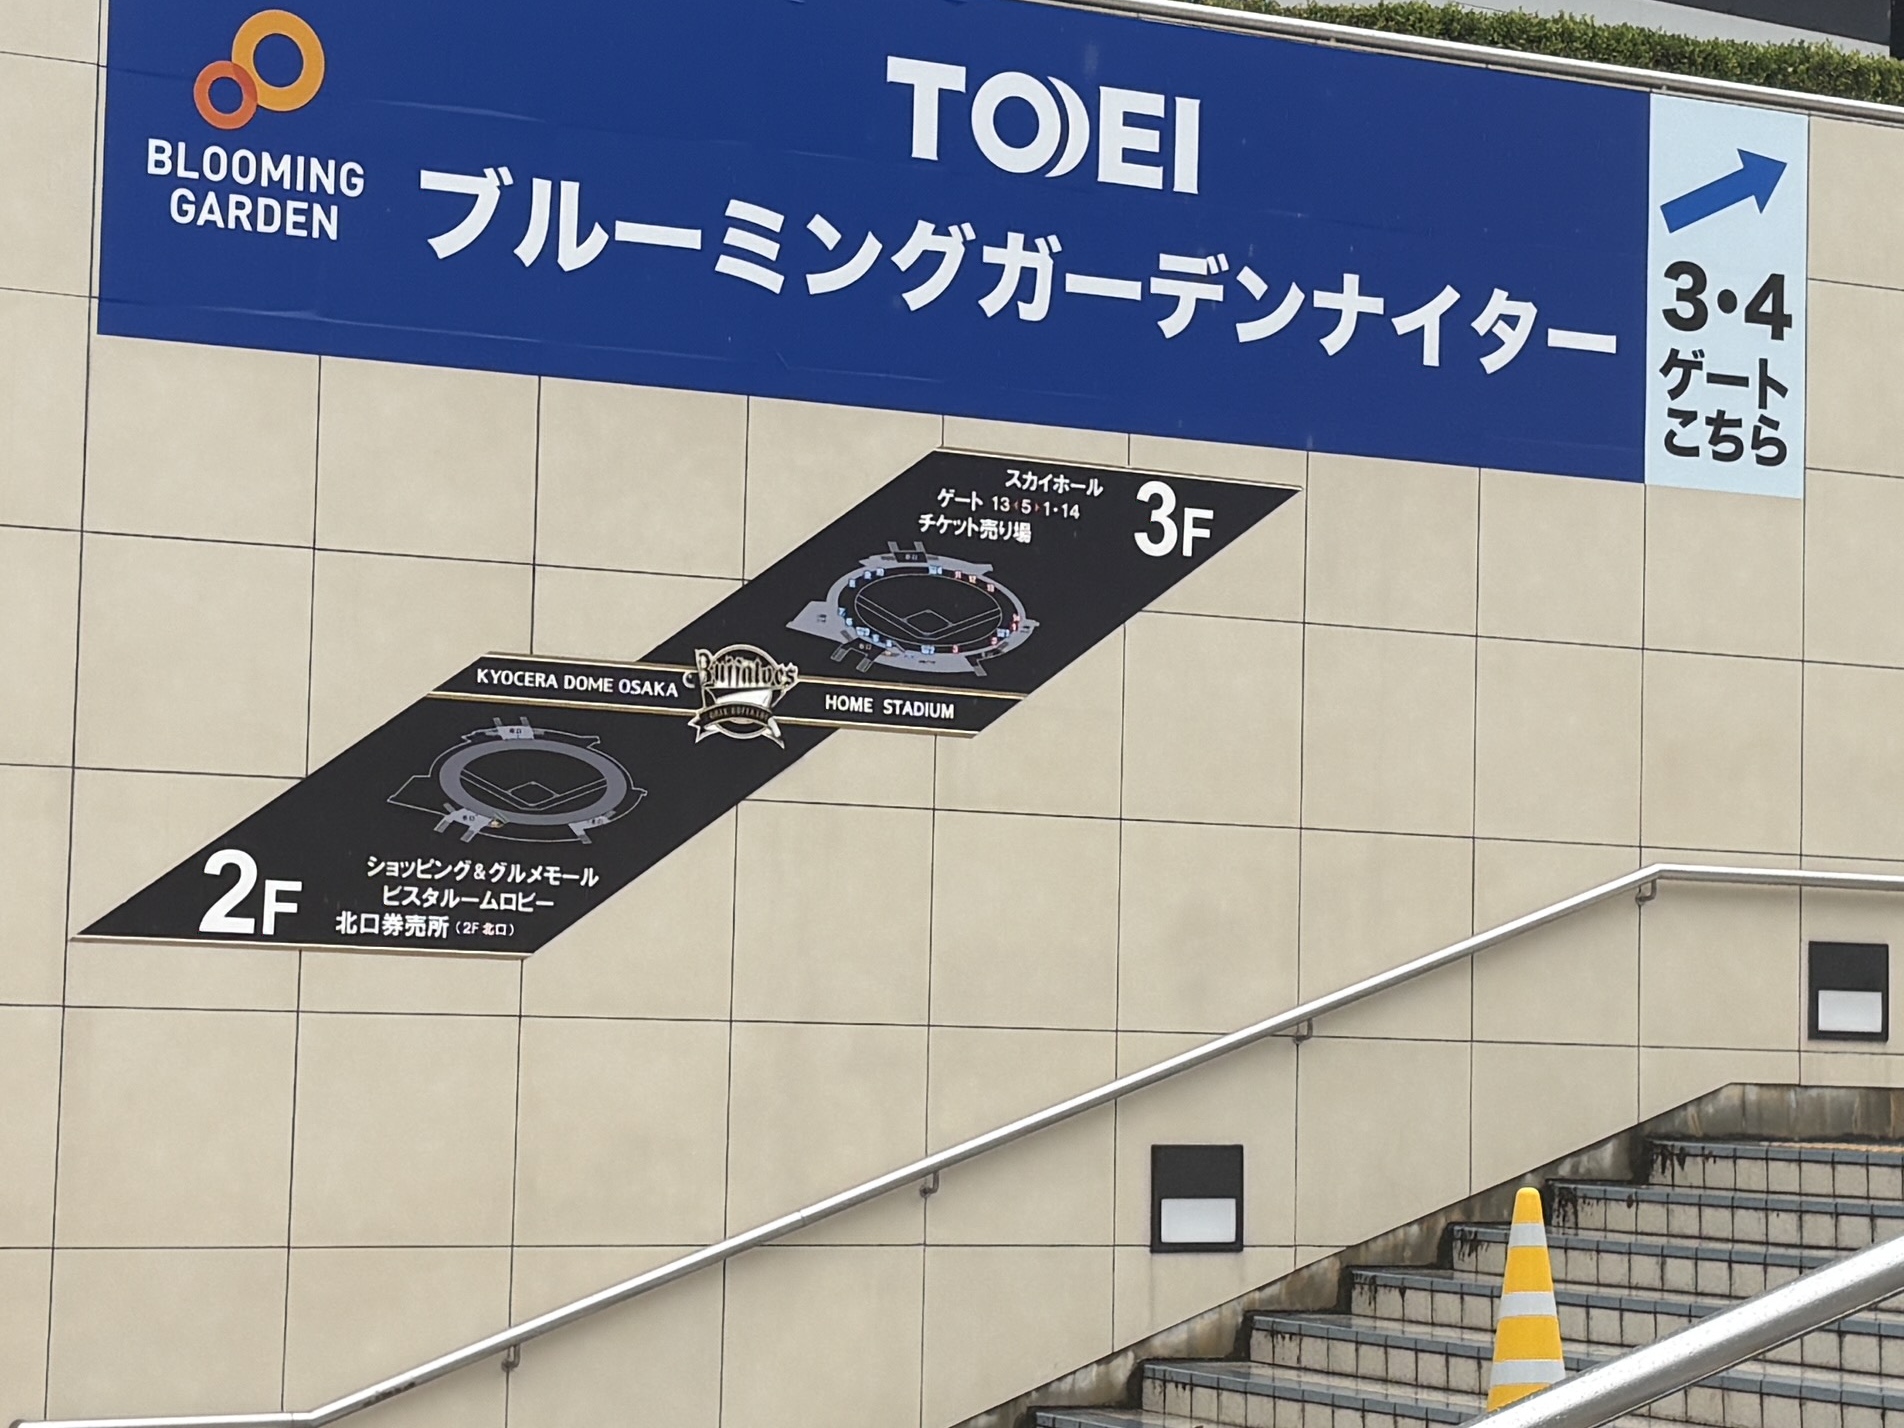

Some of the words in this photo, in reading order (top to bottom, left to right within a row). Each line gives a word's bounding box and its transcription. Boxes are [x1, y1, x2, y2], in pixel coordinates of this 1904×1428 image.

[886, 55, 1202, 196] TOEI
[146, 137, 367, 199] BLOOMING
[169, 185, 342, 242] GARDEN
[419, 166, 1620, 375] ブルーミングガーデンナイター
[1659, 347, 1789, 410] ゲート
[1664, 407, 1789, 467] こちら
[937, 488, 984, 512] ゲート
[1004, 468, 1104, 497] スカイホール
[918, 513, 1032, 544] チケット売り場
[1134, 480, 1214, 558] 3F
[476, 667, 559, 689] KYOCERA
[563, 672, 614, 693] DOME
[618, 677, 679, 698] OSAKA
[683, 646, 799, 692] Buffaloes
[825, 693, 873, 714] HOME
[882, 698, 955, 720] STADIUM
[198, 847, 303, 936] 2F
[382, 884, 555, 909] ビスタルームロビー
[335, 911, 450, 940] 北口券売所
